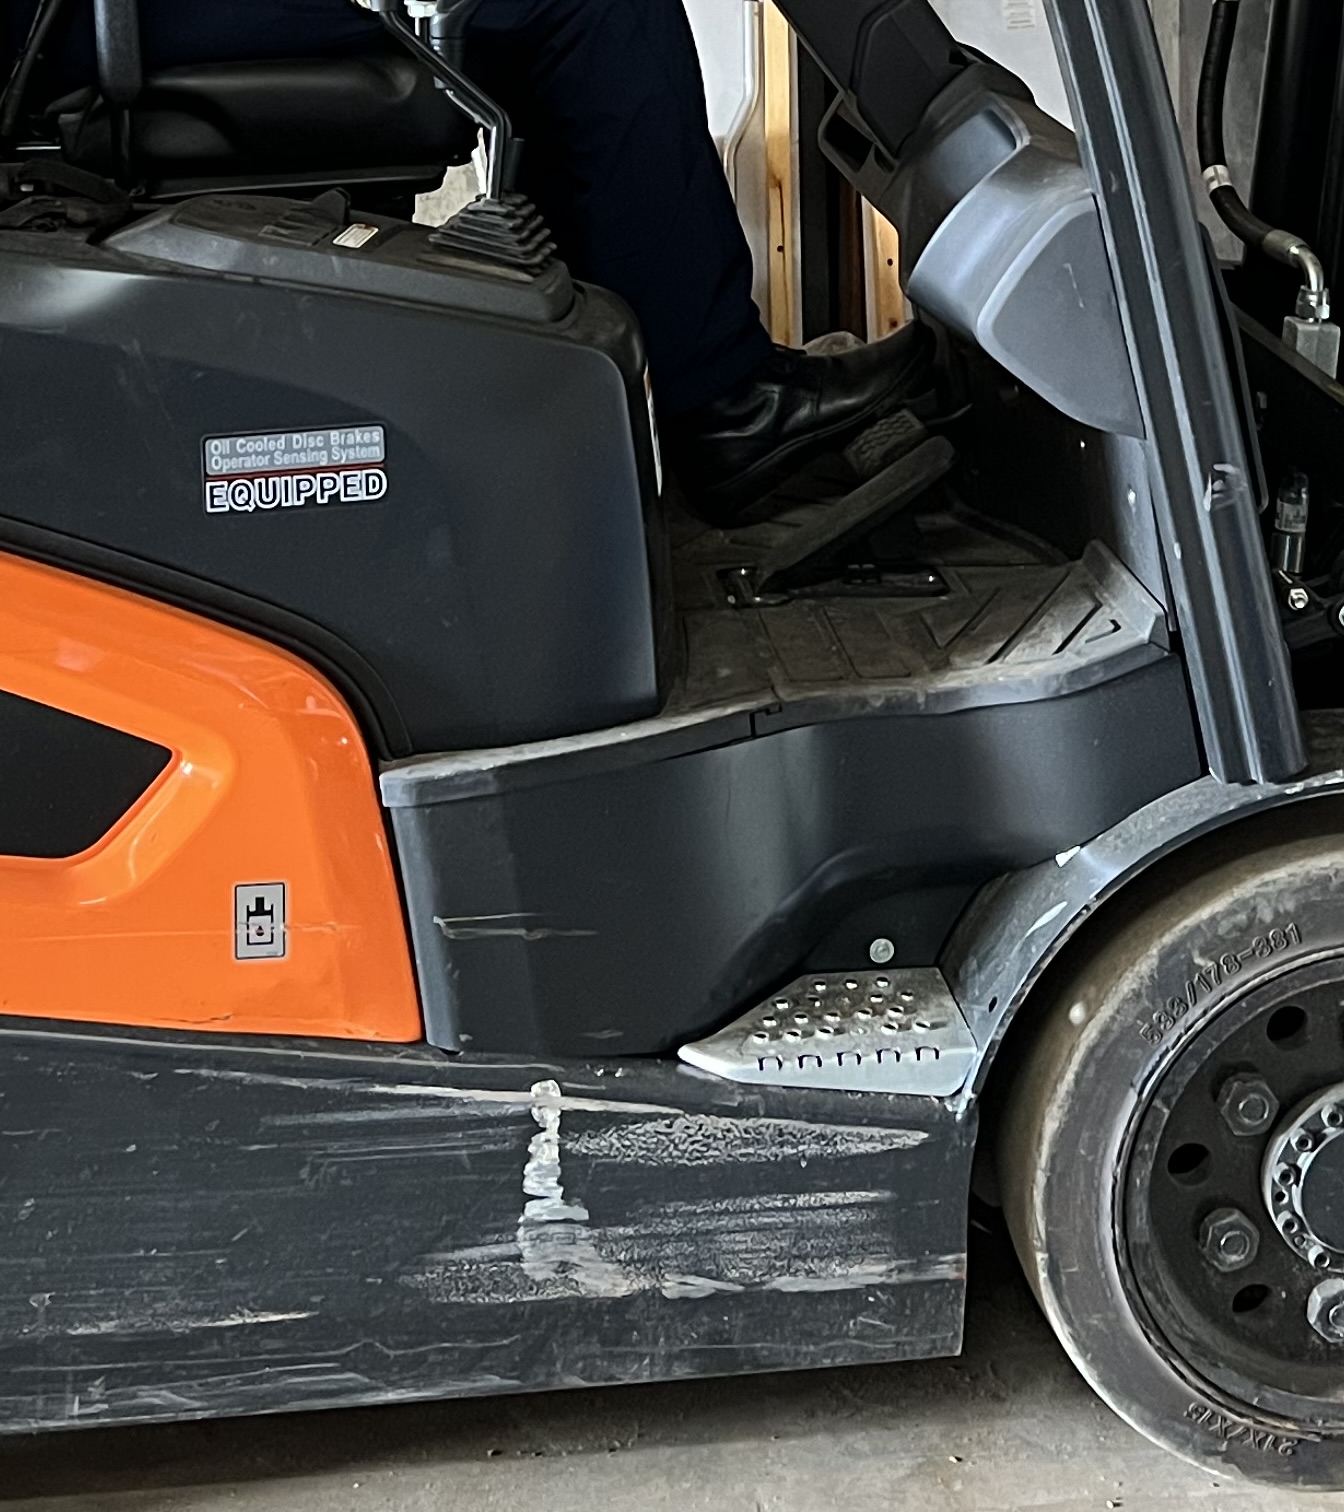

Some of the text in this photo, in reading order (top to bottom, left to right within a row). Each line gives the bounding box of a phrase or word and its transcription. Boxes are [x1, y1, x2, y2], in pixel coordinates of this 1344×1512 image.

[211, 429, 380, 455] Oil Cooled Disc Brakes
[211, 445, 380, 472] Operator Sensing System
[206, 468, 387, 513] EQUIPPED
